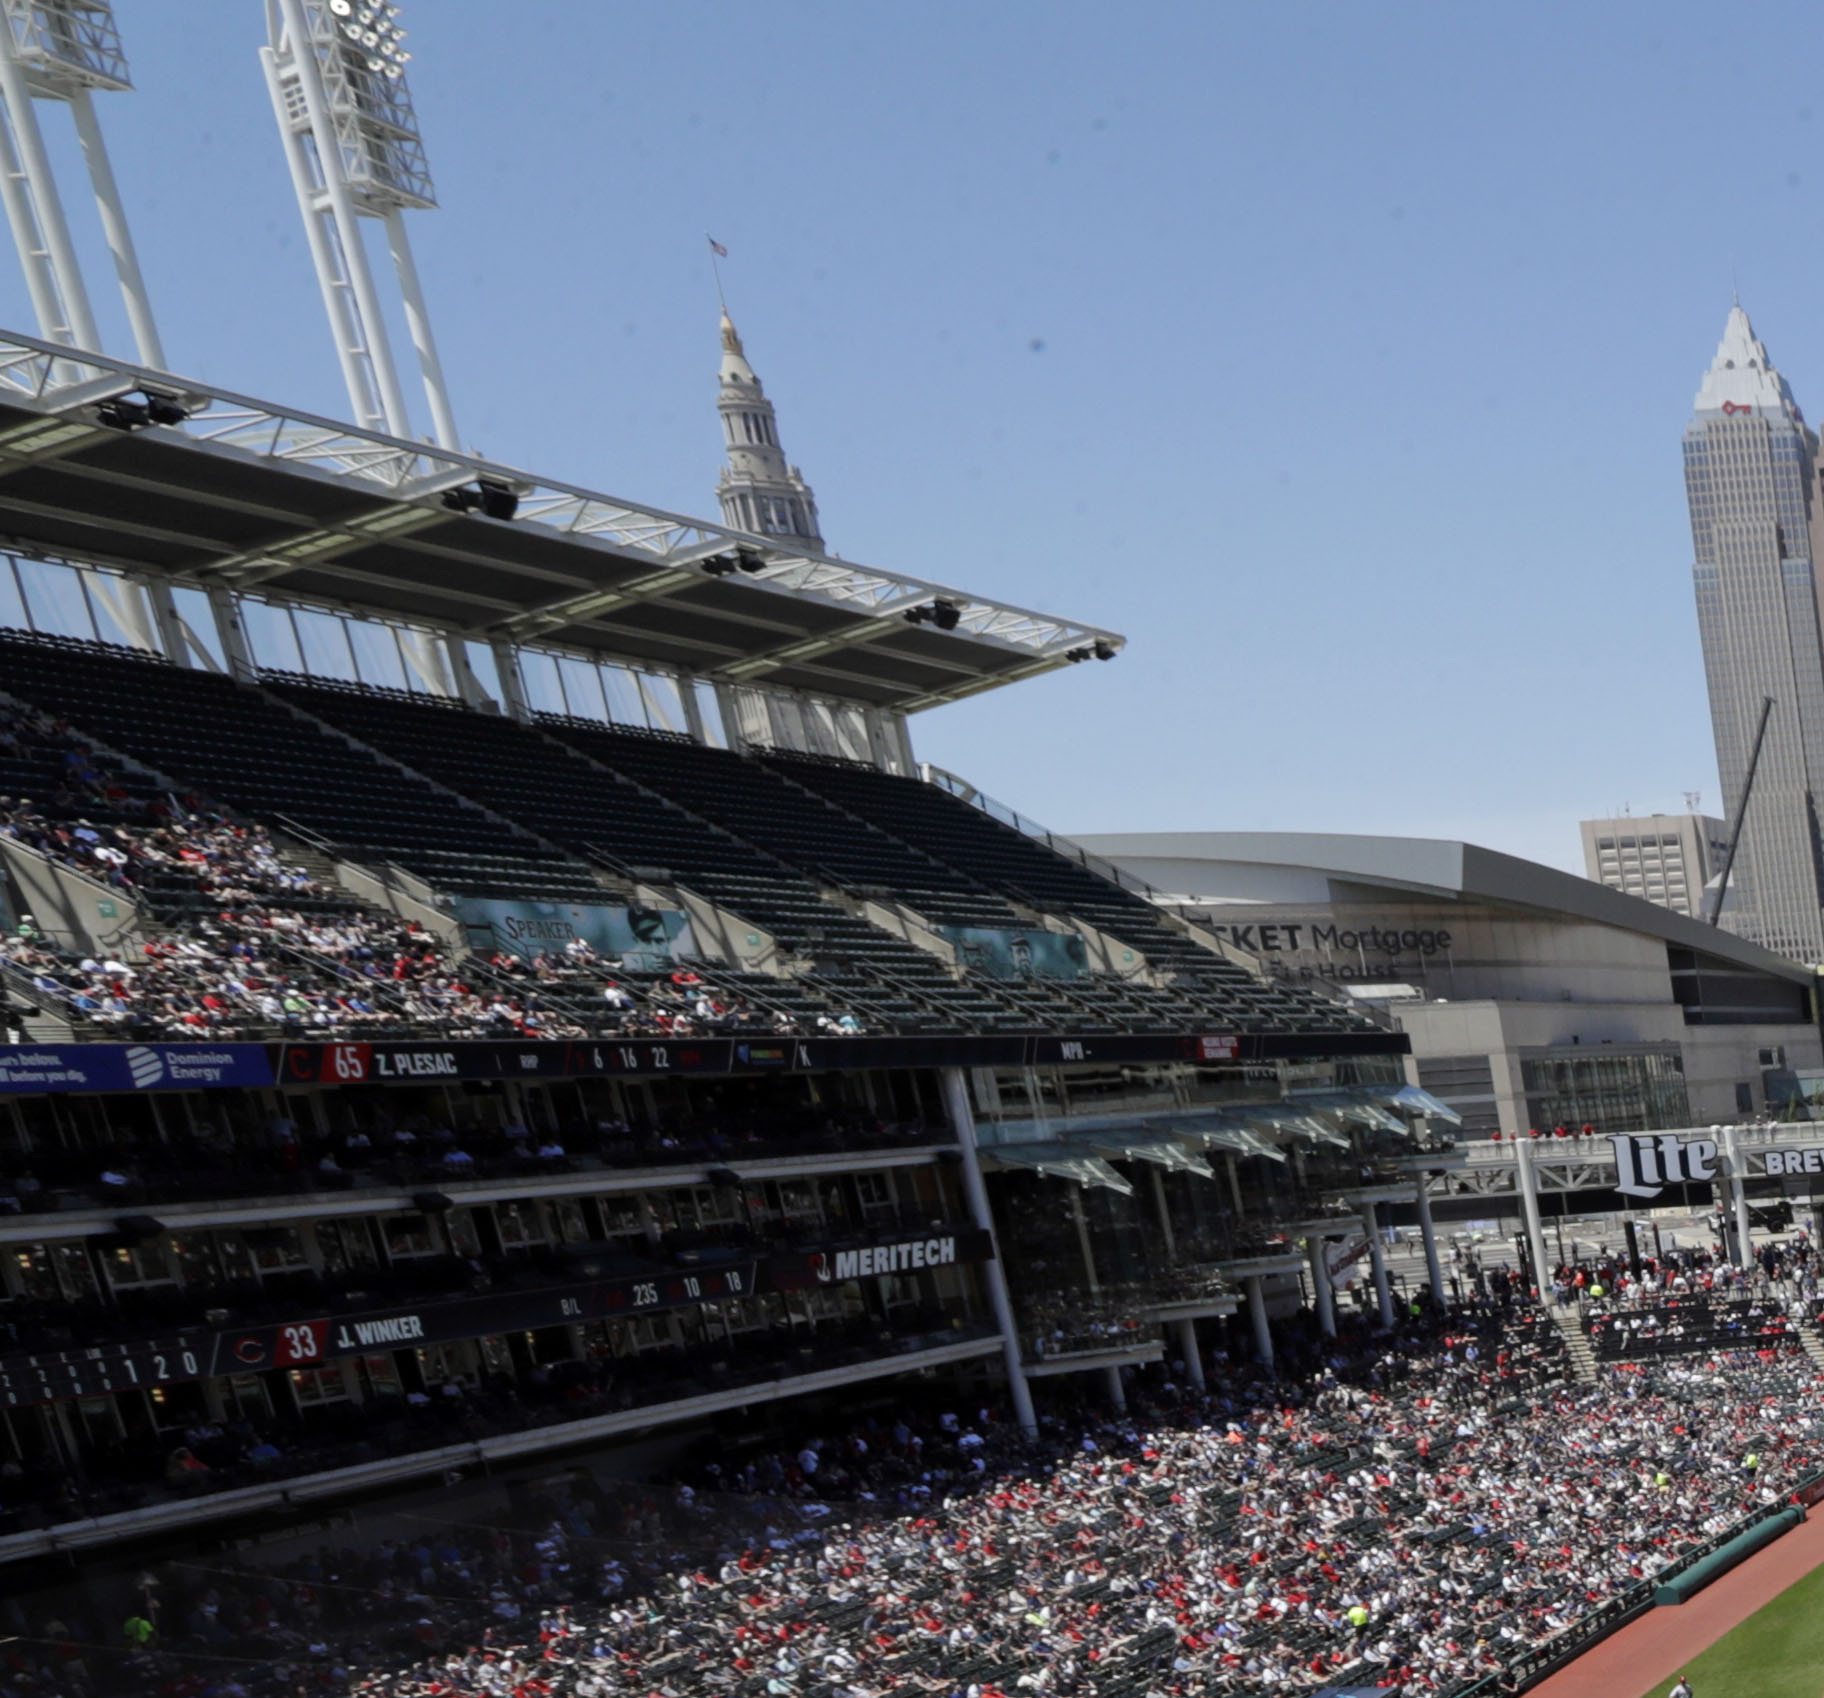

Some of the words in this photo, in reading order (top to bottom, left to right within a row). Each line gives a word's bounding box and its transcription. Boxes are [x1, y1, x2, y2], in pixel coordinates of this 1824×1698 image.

[506, 915, 575, 941] SPEAKER
[1312, 924, 1452, 955] Mortgage
[167, 1051, 235, 1066] Dominion
[171, 1066, 222, 1082] Energy
[334, 1046, 364, 1079] 65
[378, 1055, 394, 1075] Z.
[395, 1052, 458, 1075] PLESAC
[1608, 1133, 1718, 1198] Lite
[834, 1236, 956, 1280] MERITECH
[285, 1326, 318, 1359] 33
[356, 1315, 424, 1346] WINKER
